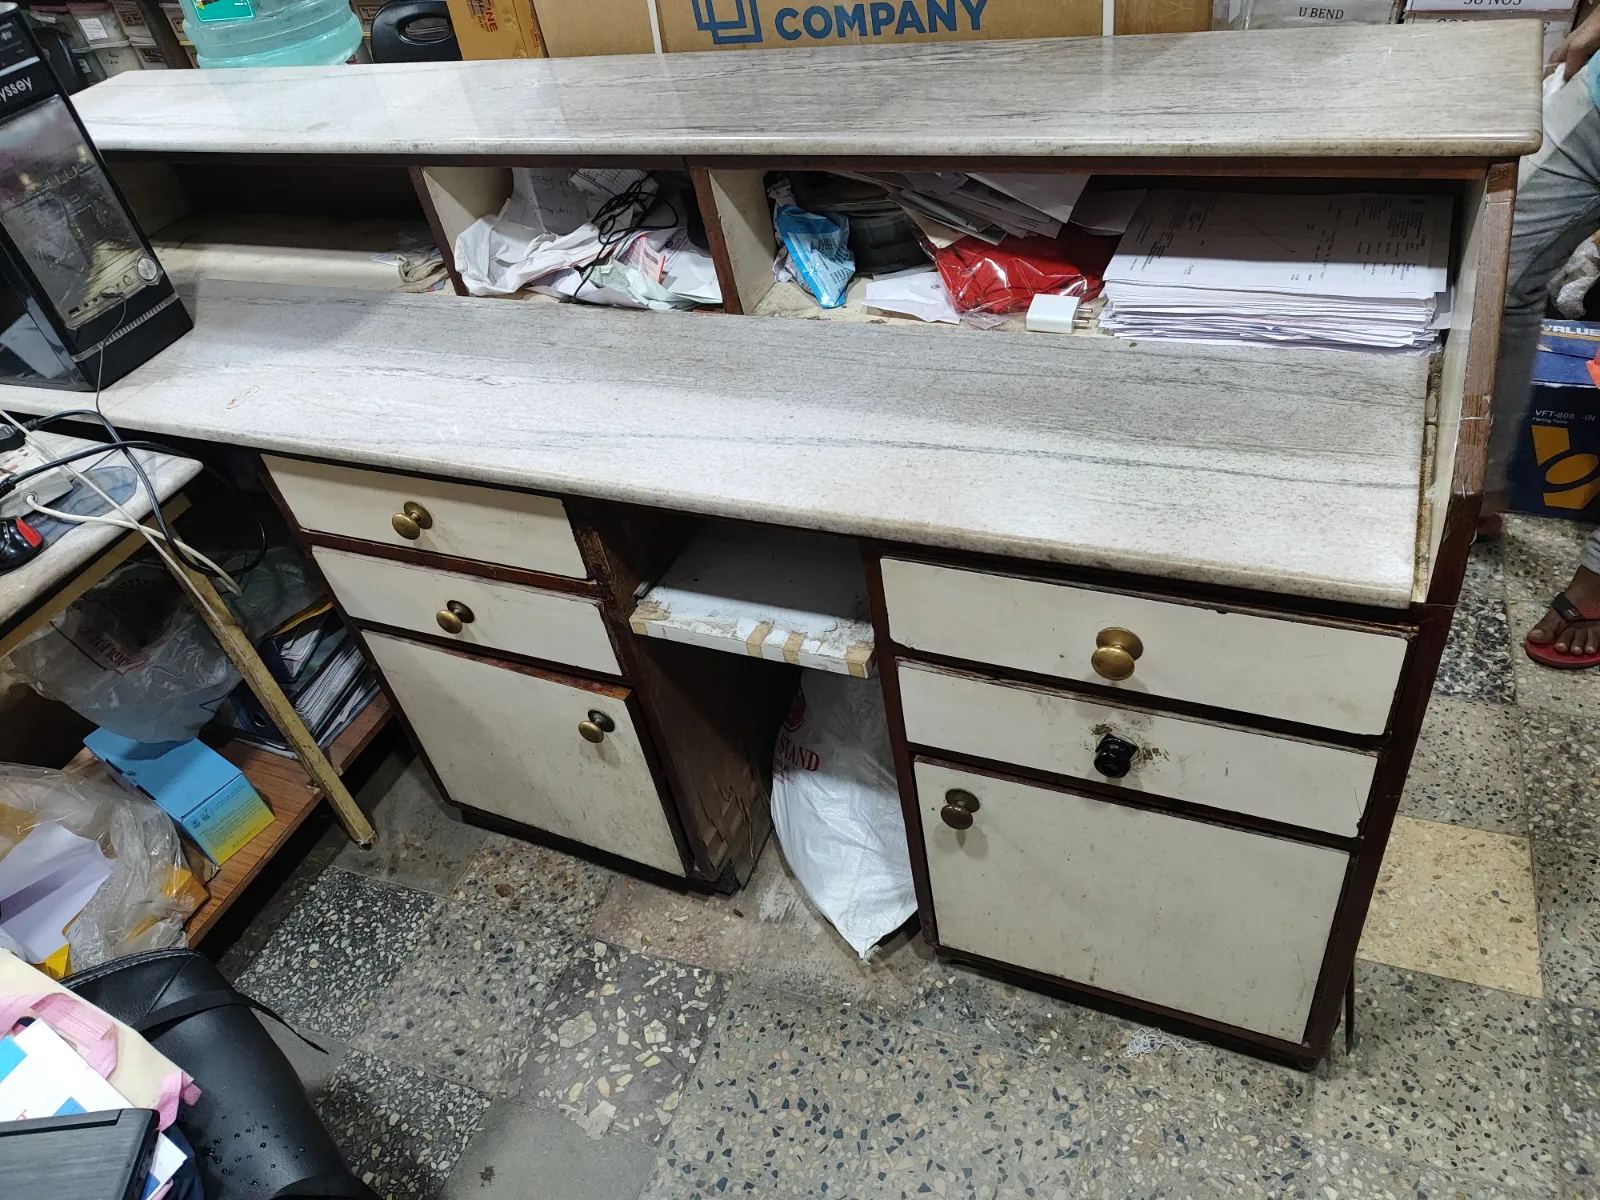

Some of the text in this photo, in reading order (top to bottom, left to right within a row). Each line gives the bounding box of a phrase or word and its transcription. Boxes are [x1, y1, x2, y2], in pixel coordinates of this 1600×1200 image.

[774, 0, 989, 41] COMPANY
[1298, 6, 1344, 20] U BEND
